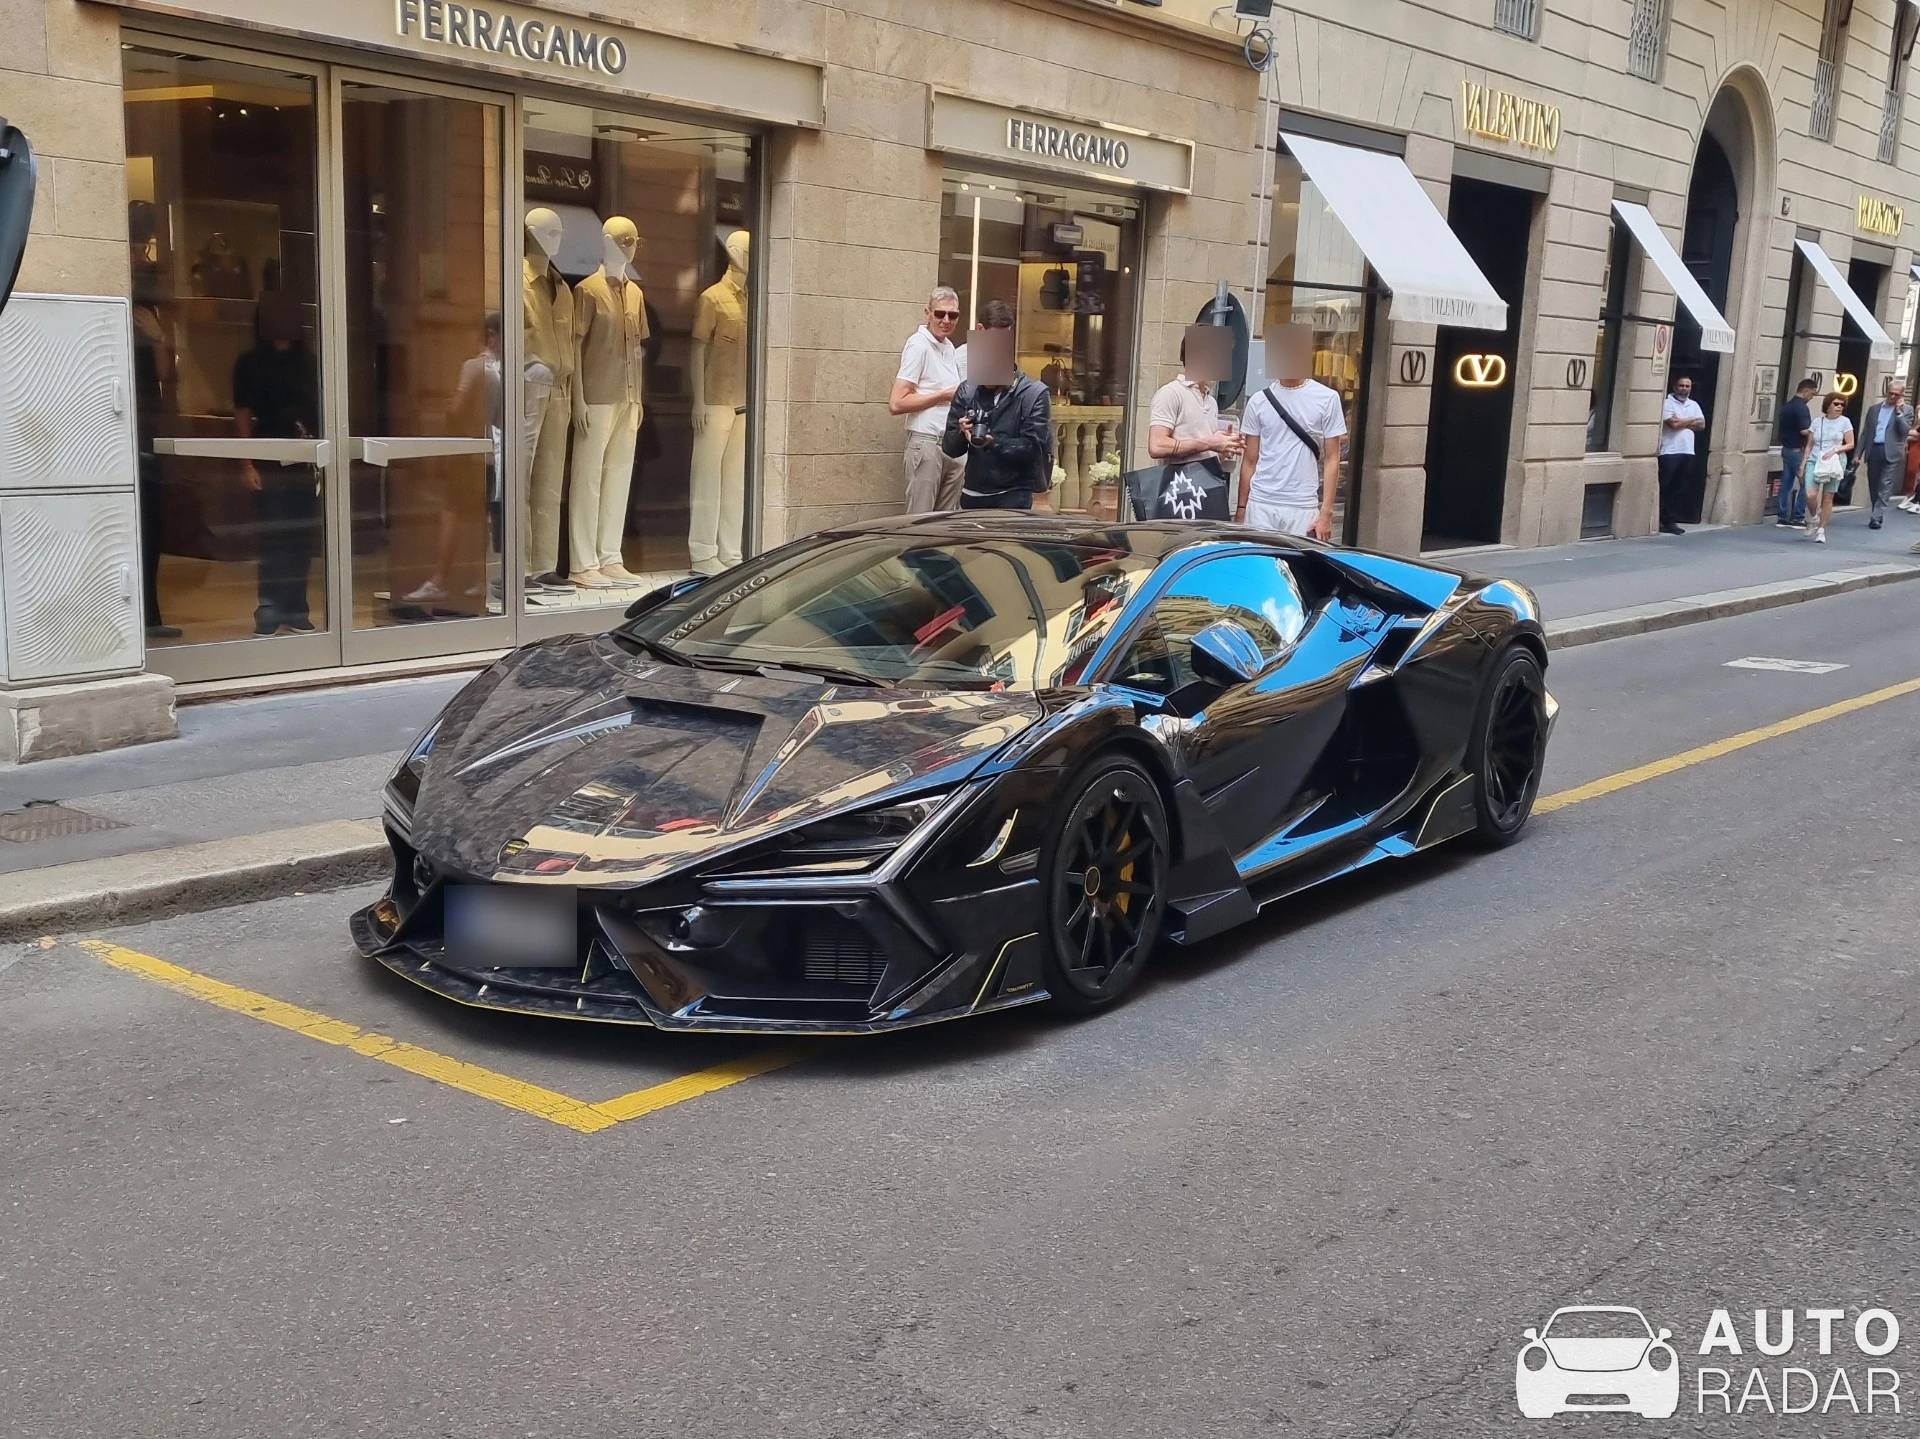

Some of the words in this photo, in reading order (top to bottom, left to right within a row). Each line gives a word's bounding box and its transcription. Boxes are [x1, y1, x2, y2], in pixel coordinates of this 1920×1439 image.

[395, 0, 627, 75] FERRAGAMO
[1006, 118, 1129, 169] FERRAGAMO
[1461, 80, 1561, 152] VALENTINO
